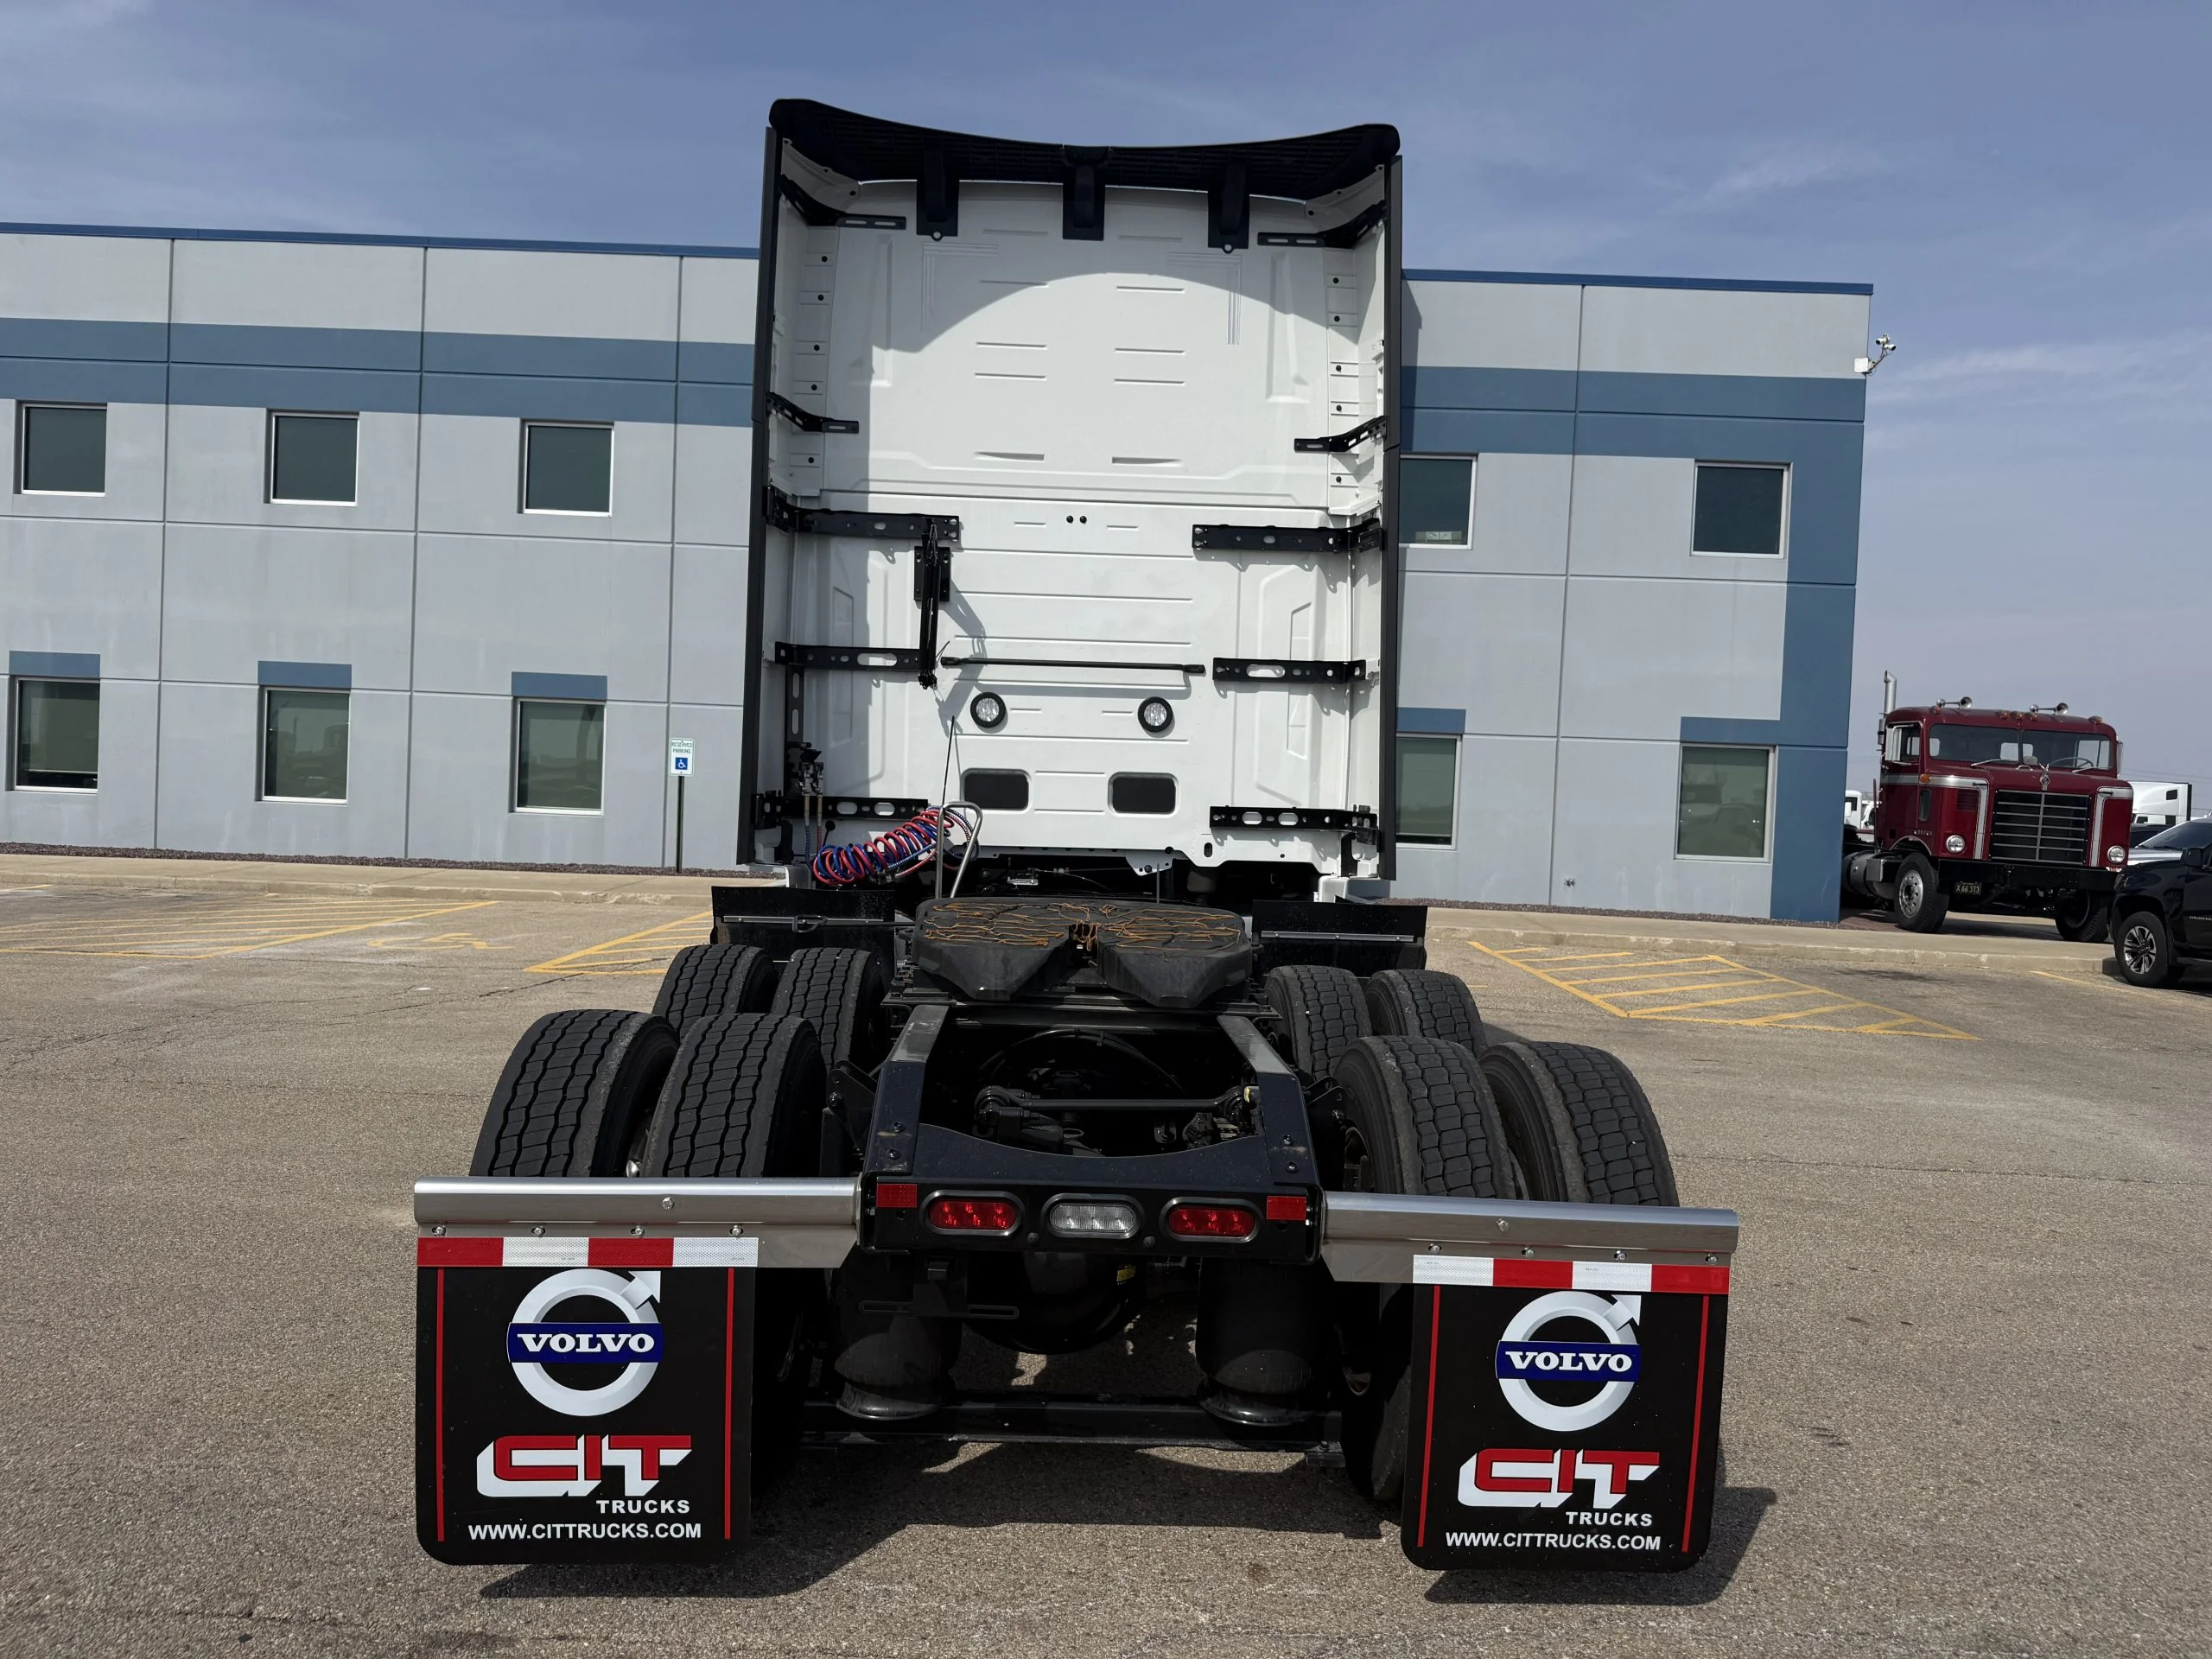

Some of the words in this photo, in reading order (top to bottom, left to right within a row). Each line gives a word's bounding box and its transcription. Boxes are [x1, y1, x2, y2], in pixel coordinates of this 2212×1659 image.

[517, 1332, 655, 1353] VOLVO
[1505, 1351, 1632, 1372] VOLVO
[477, 1434, 692, 1497] CIT
[1458, 1448, 1660, 1510] CIT
[596, 1499, 690, 1514] TRUCKS
[1566, 1511, 1653, 1527] TRUCKS
[467, 1523, 702, 1541] WWW.CITTRUCKS.COM
[1446, 1531, 1661, 1551] WWW.CITTRUCKS.COM
